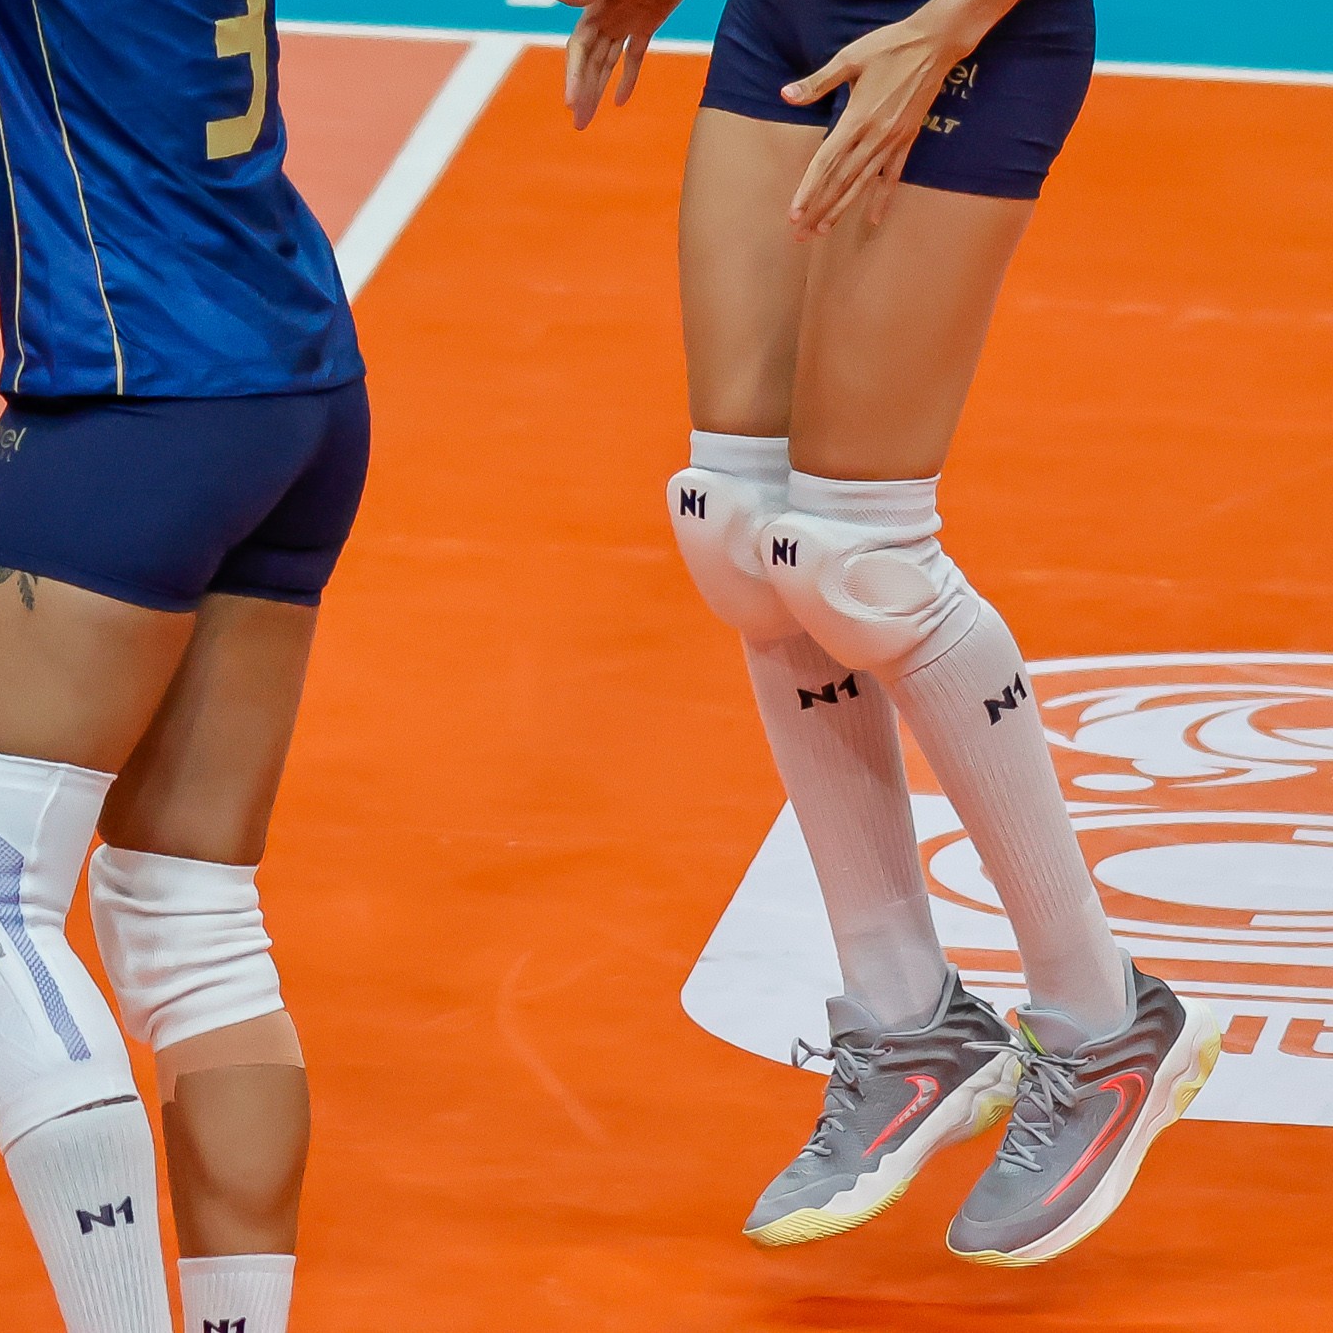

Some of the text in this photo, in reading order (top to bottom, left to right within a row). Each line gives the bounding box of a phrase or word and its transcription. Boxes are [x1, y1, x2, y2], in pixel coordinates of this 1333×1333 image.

[679, 487, 708, 520] N1
[771, 536, 799, 567] N1
[796, 673, 860, 711] N1
[983, 672, 1028, 726] N1
[76, 1195, 134, 1236] N1
